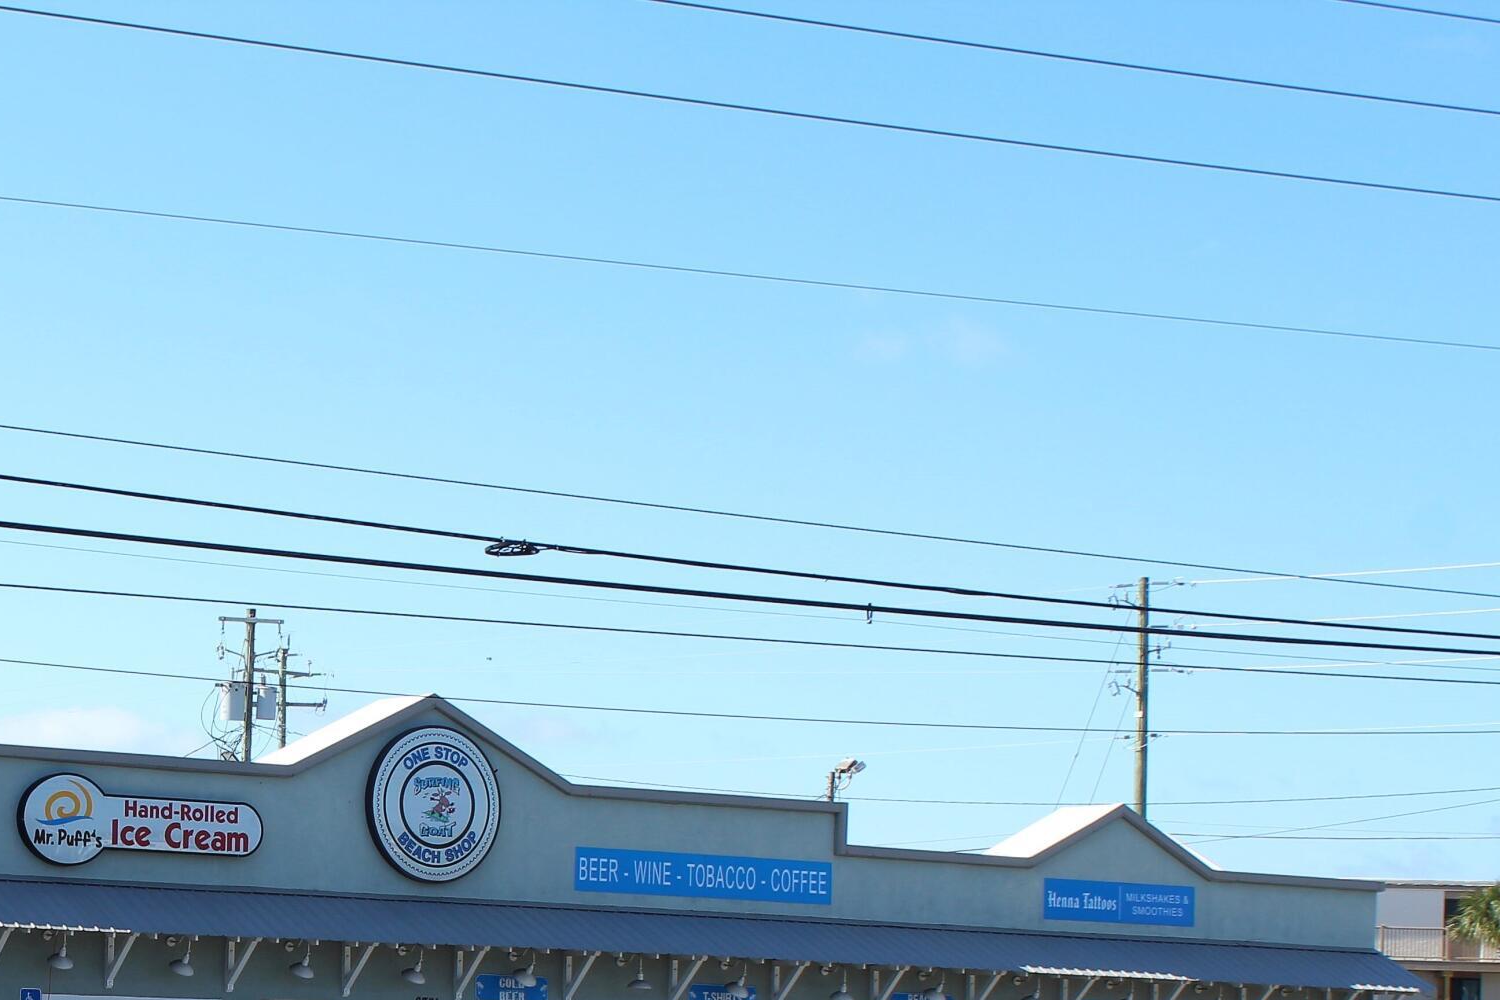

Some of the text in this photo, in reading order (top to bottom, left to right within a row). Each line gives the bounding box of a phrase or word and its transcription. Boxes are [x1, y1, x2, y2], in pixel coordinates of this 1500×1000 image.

[403, 746, 469, 770] ONE STOP
[413, 776, 461, 796] SURFING
[124, 799, 239, 824] Hand-Rolled
[33, 828, 103, 849] Mr. Puff's
[111, 819, 249, 853] Ice Cream
[419, 821, 457, 838] GOAT
[397, 830, 477, 864] BEACH SHOP
[578, 857, 619, 883] BEER
[634, 860, 672, 886] WINE
[686, 863, 756, 890] TOBACCO
[770, 868, 828, 895] COFFEE
[1047, 890, 1117, 911] Henna Tattoos
[1125, 893, 1189, 905] MILKSHAKES &
[1131, 905, 1184, 917] SMOOTHIES
